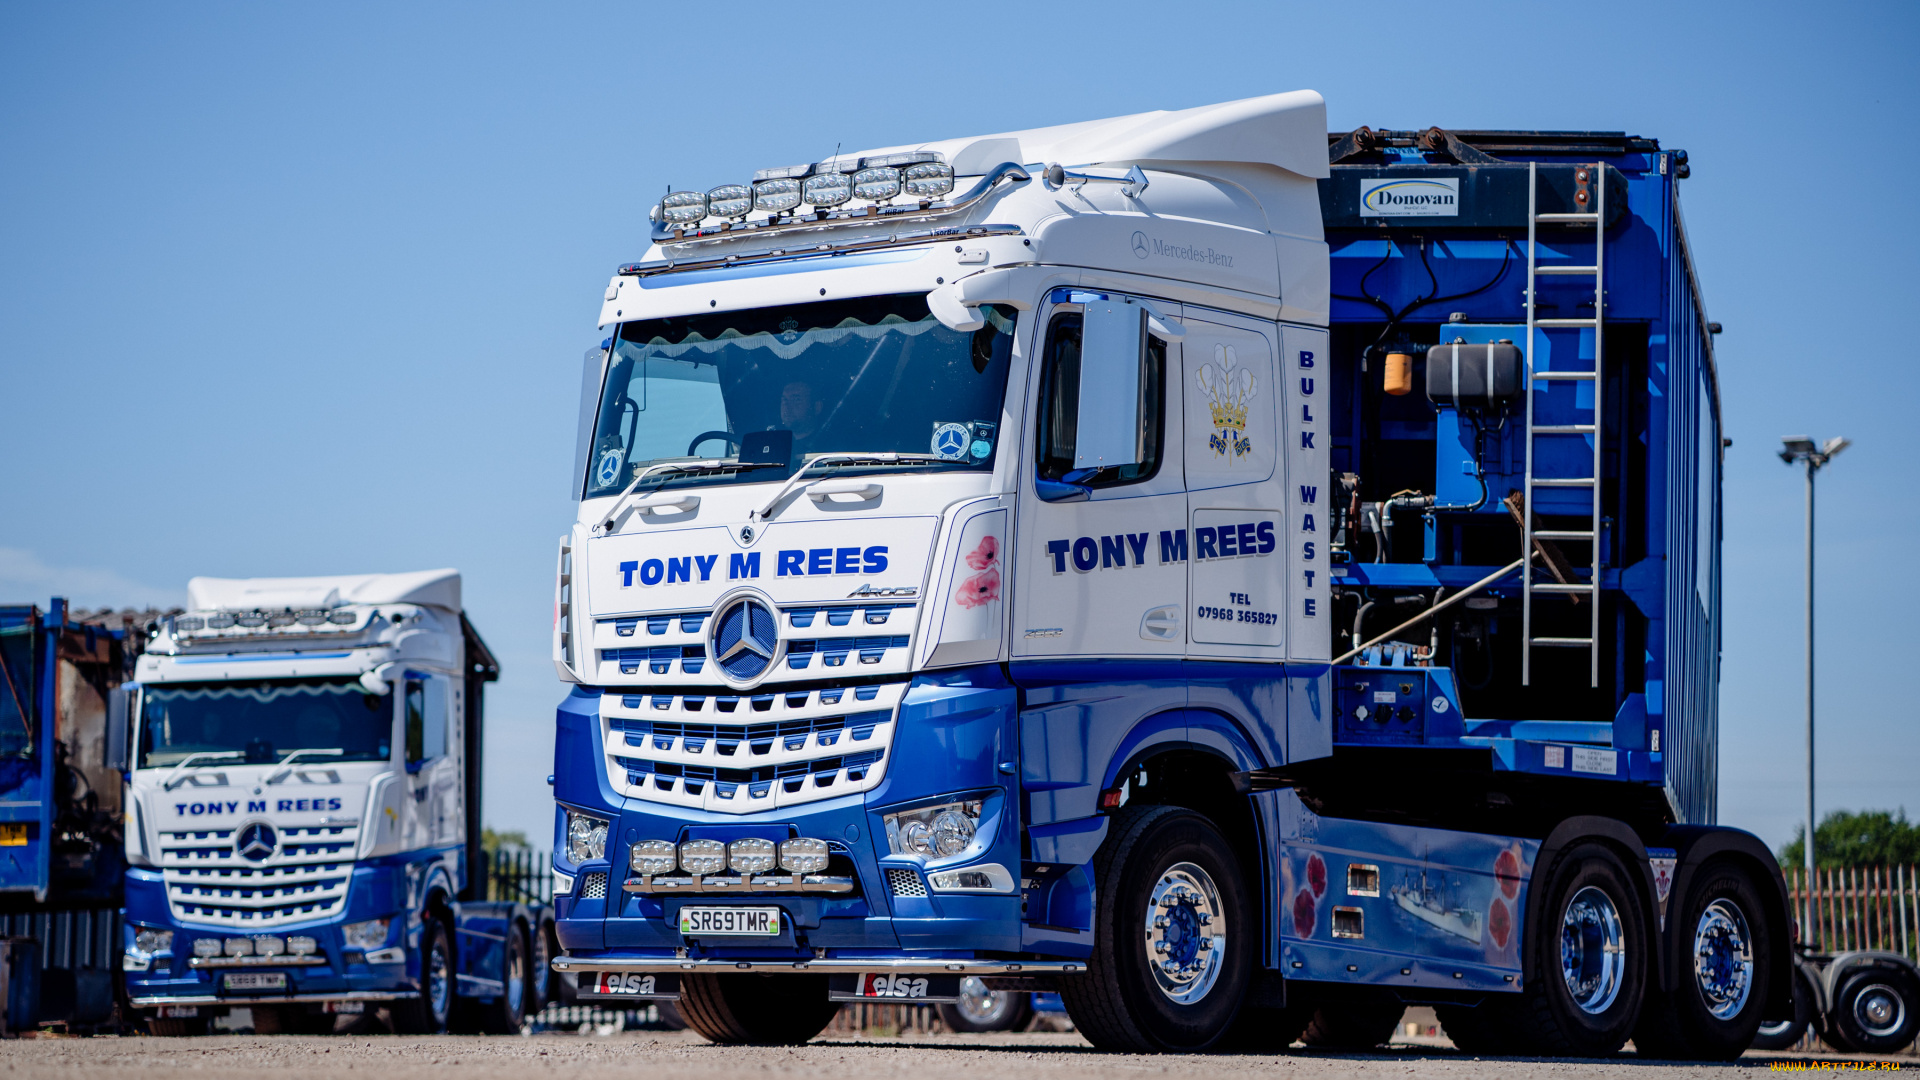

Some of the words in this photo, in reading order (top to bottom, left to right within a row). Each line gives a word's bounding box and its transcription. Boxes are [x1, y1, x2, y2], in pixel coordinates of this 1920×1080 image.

[1378, 190, 1455, 206] Donovan
[1153, 238, 1234, 268] Mercedes-Benz
[1299, 350, 1315, 450] BULK
[1047, 532, 1149, 573] TONY
[1159, 529, 1188, 563] M
[1195, 521, 1276, 559] REES
[1300, 485, 1317, 616] WASTE
[618, 553, 719, 588] TONY
[728, 551, 761, 580] M
[776, 546, 889, 577] REES
[1229, 591, 1251, 606] TEL
[1198, 605, 1234, 621] 07968
[1237, 609, 1278, 626] 365827
[175, 801, 239, 816] TONY
[248, 800, 267, 813] M
[277, 797, 342, 811] REES
[690, 911, 768, 931] SR69TMR
[593, 972, 656, 994] Kelsa
[855, 973, 929, 997] Kelsa
